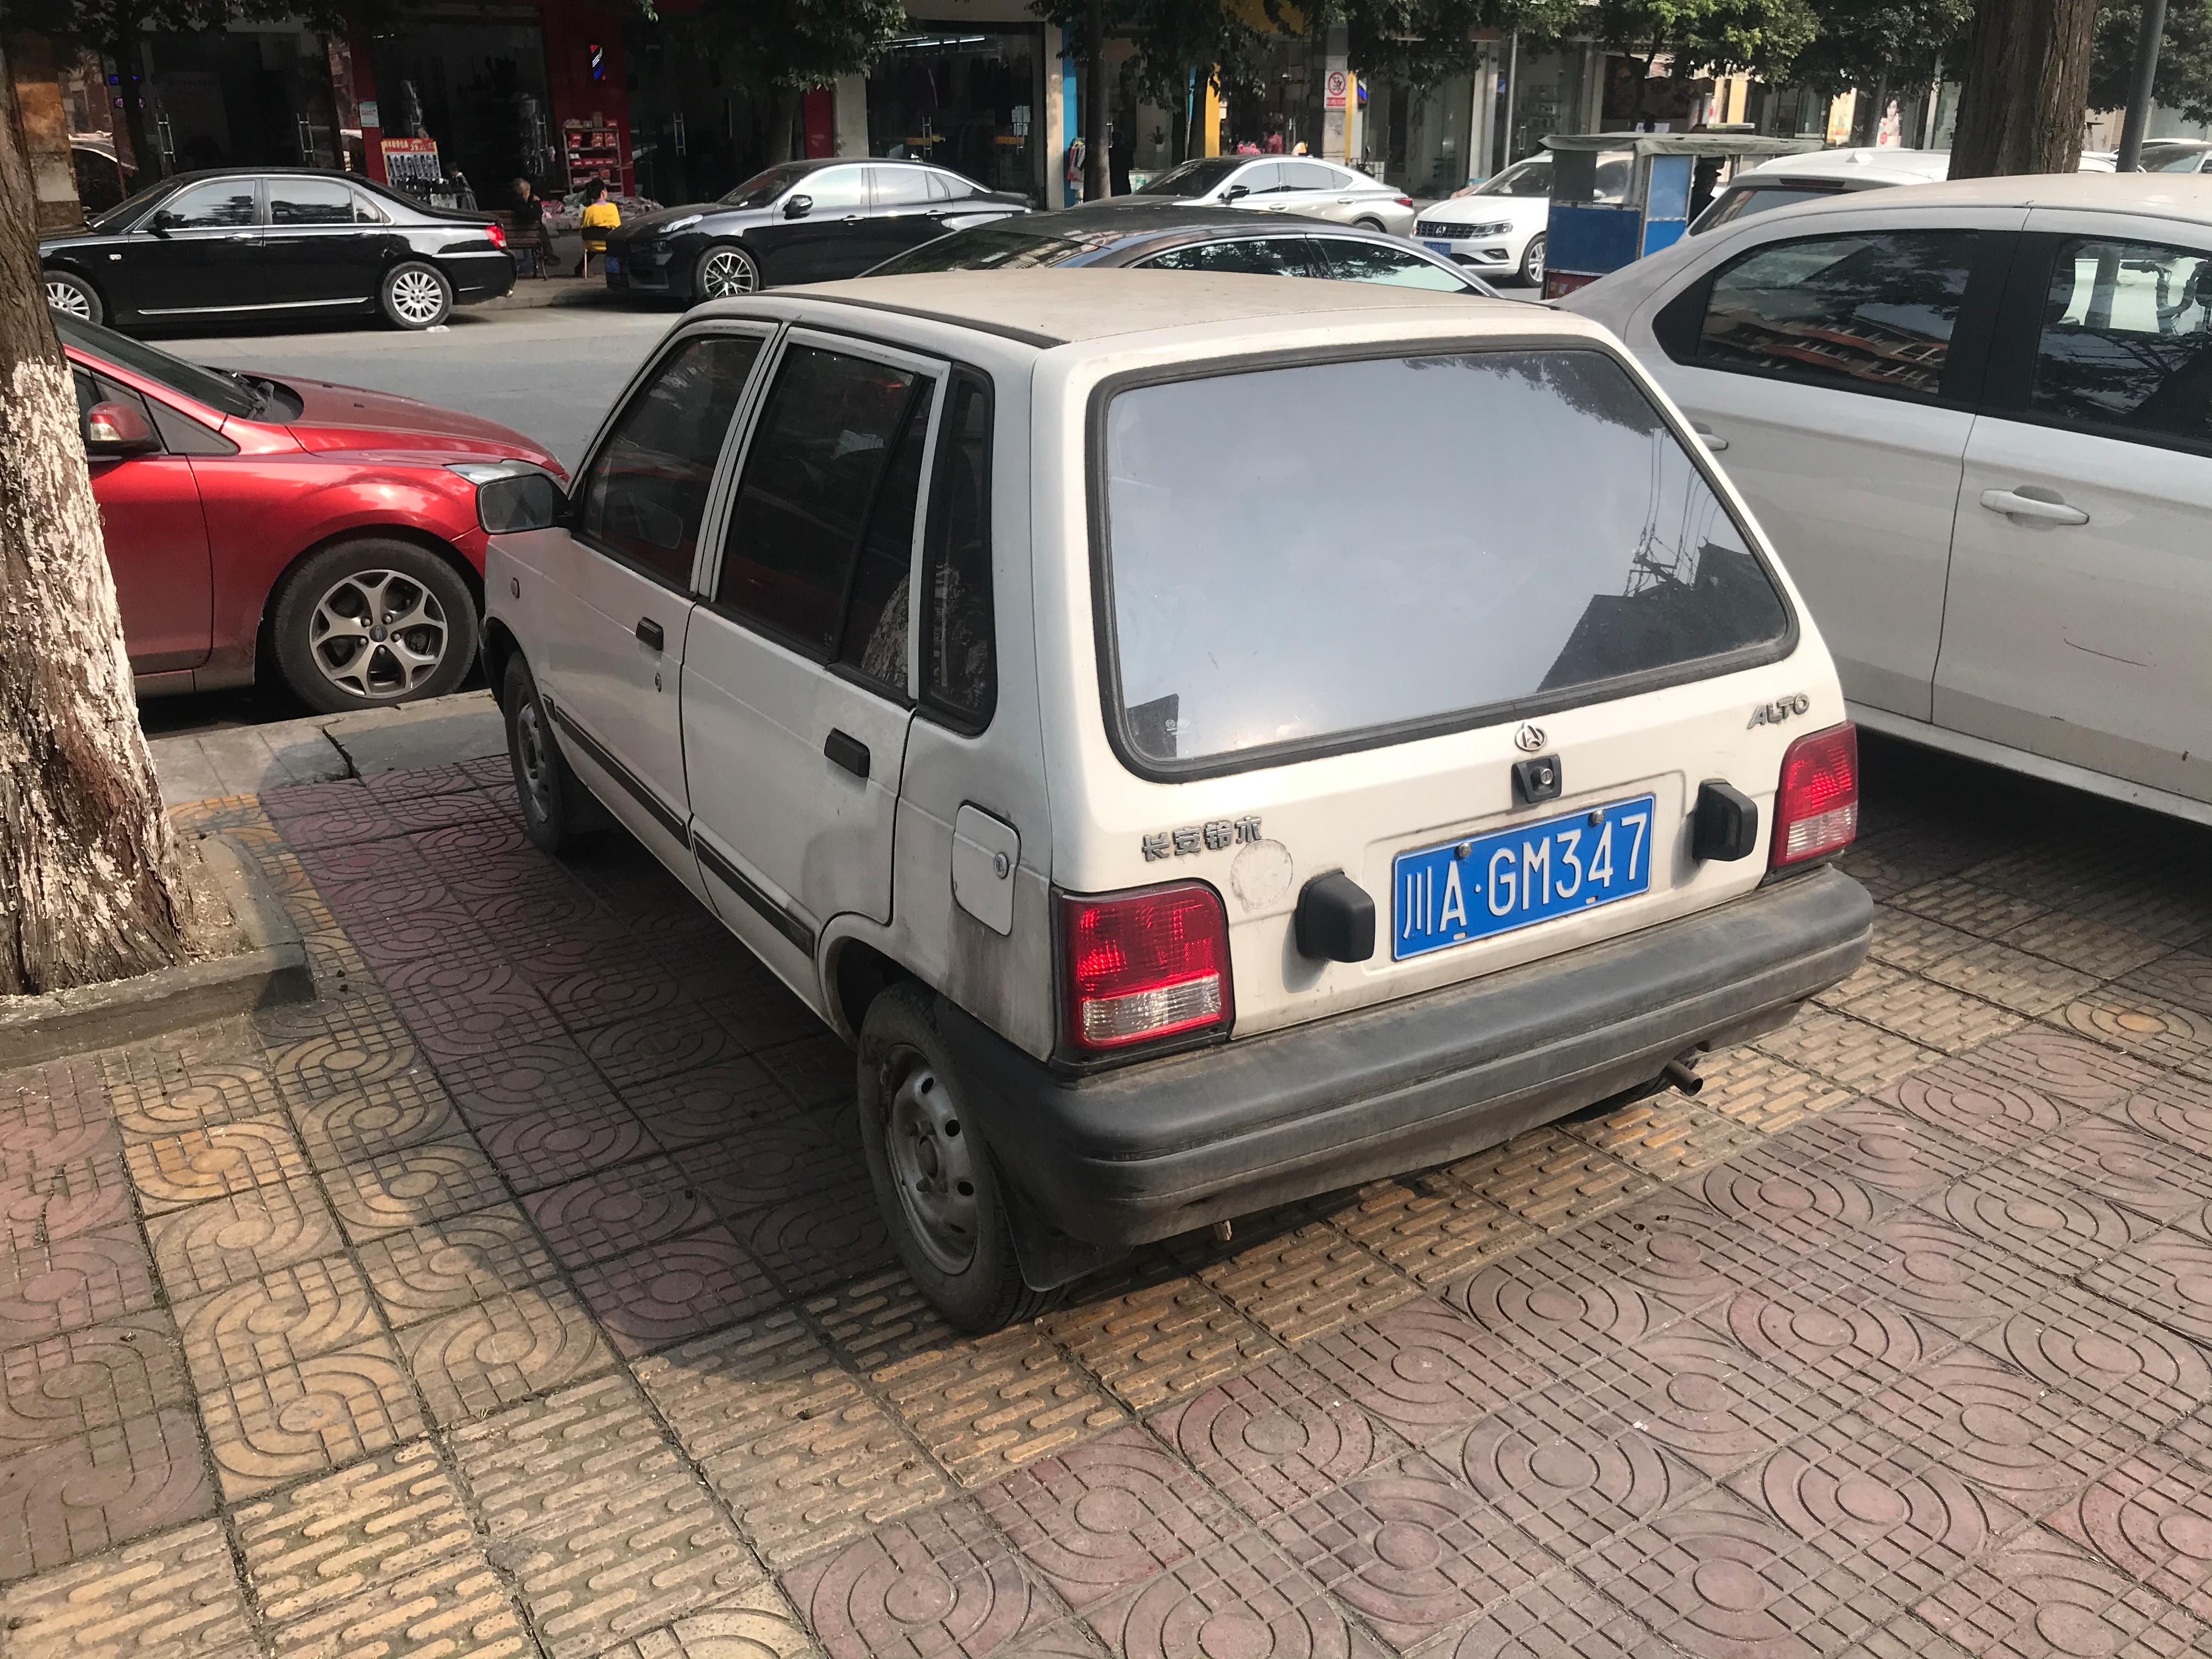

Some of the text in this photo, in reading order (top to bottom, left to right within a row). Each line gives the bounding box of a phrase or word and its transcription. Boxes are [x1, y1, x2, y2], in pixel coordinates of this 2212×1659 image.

[1747, 693, 1809, 729] ALTO
[1142, 816, 1262, 861] 长安铃木
[1402, 812, 1647, 939] 川A·GM347
